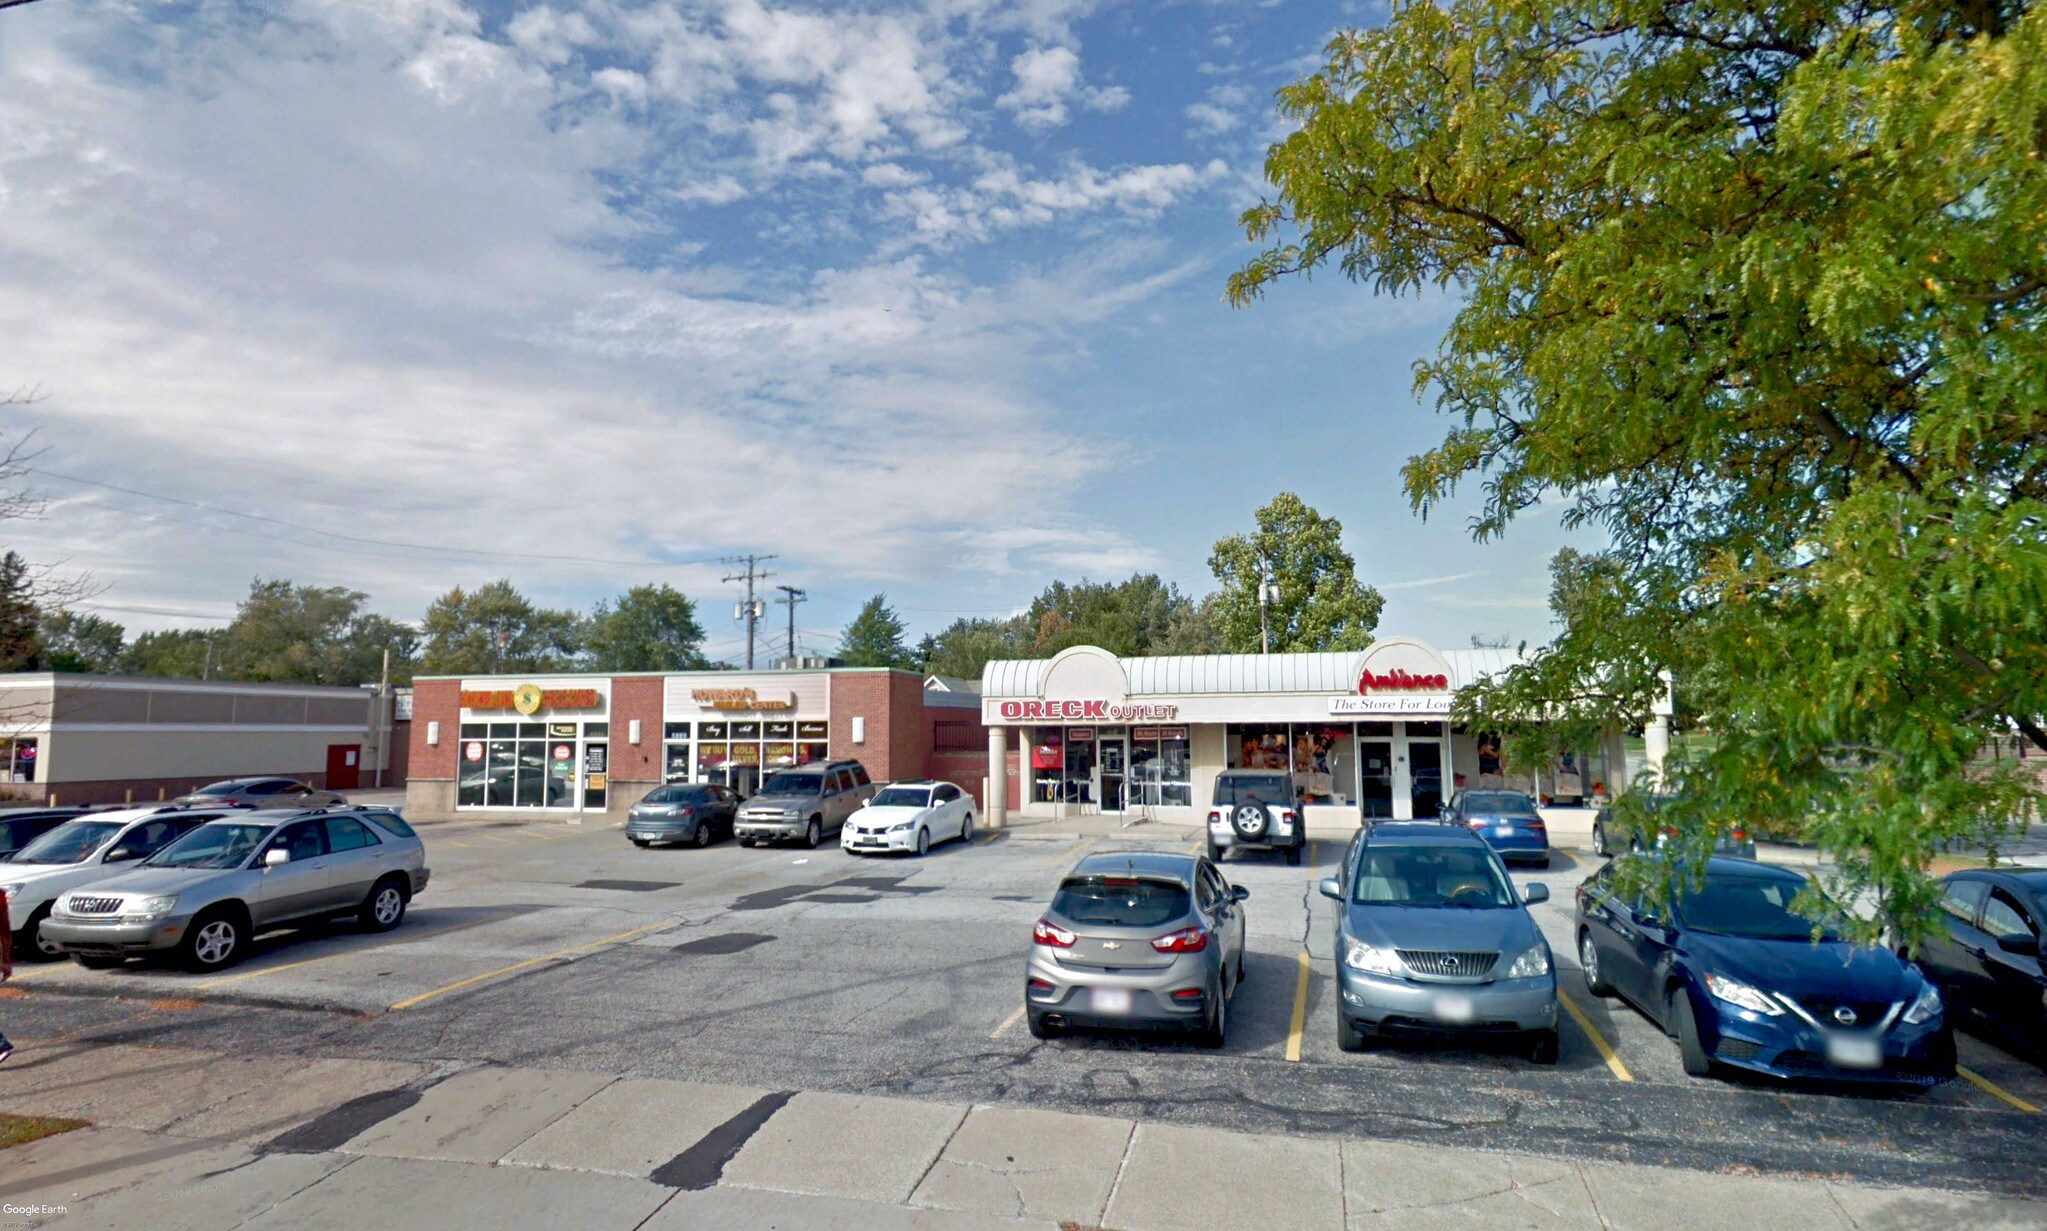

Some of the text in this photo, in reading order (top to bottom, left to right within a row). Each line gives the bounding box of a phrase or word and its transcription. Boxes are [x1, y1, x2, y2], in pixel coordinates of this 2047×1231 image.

[1359, 668, 1448, 696] Ambiance
[1000, 700, 1175, 719] ORECK OUTLET
[1334, 698, 1453, 710] The Store For Lov
